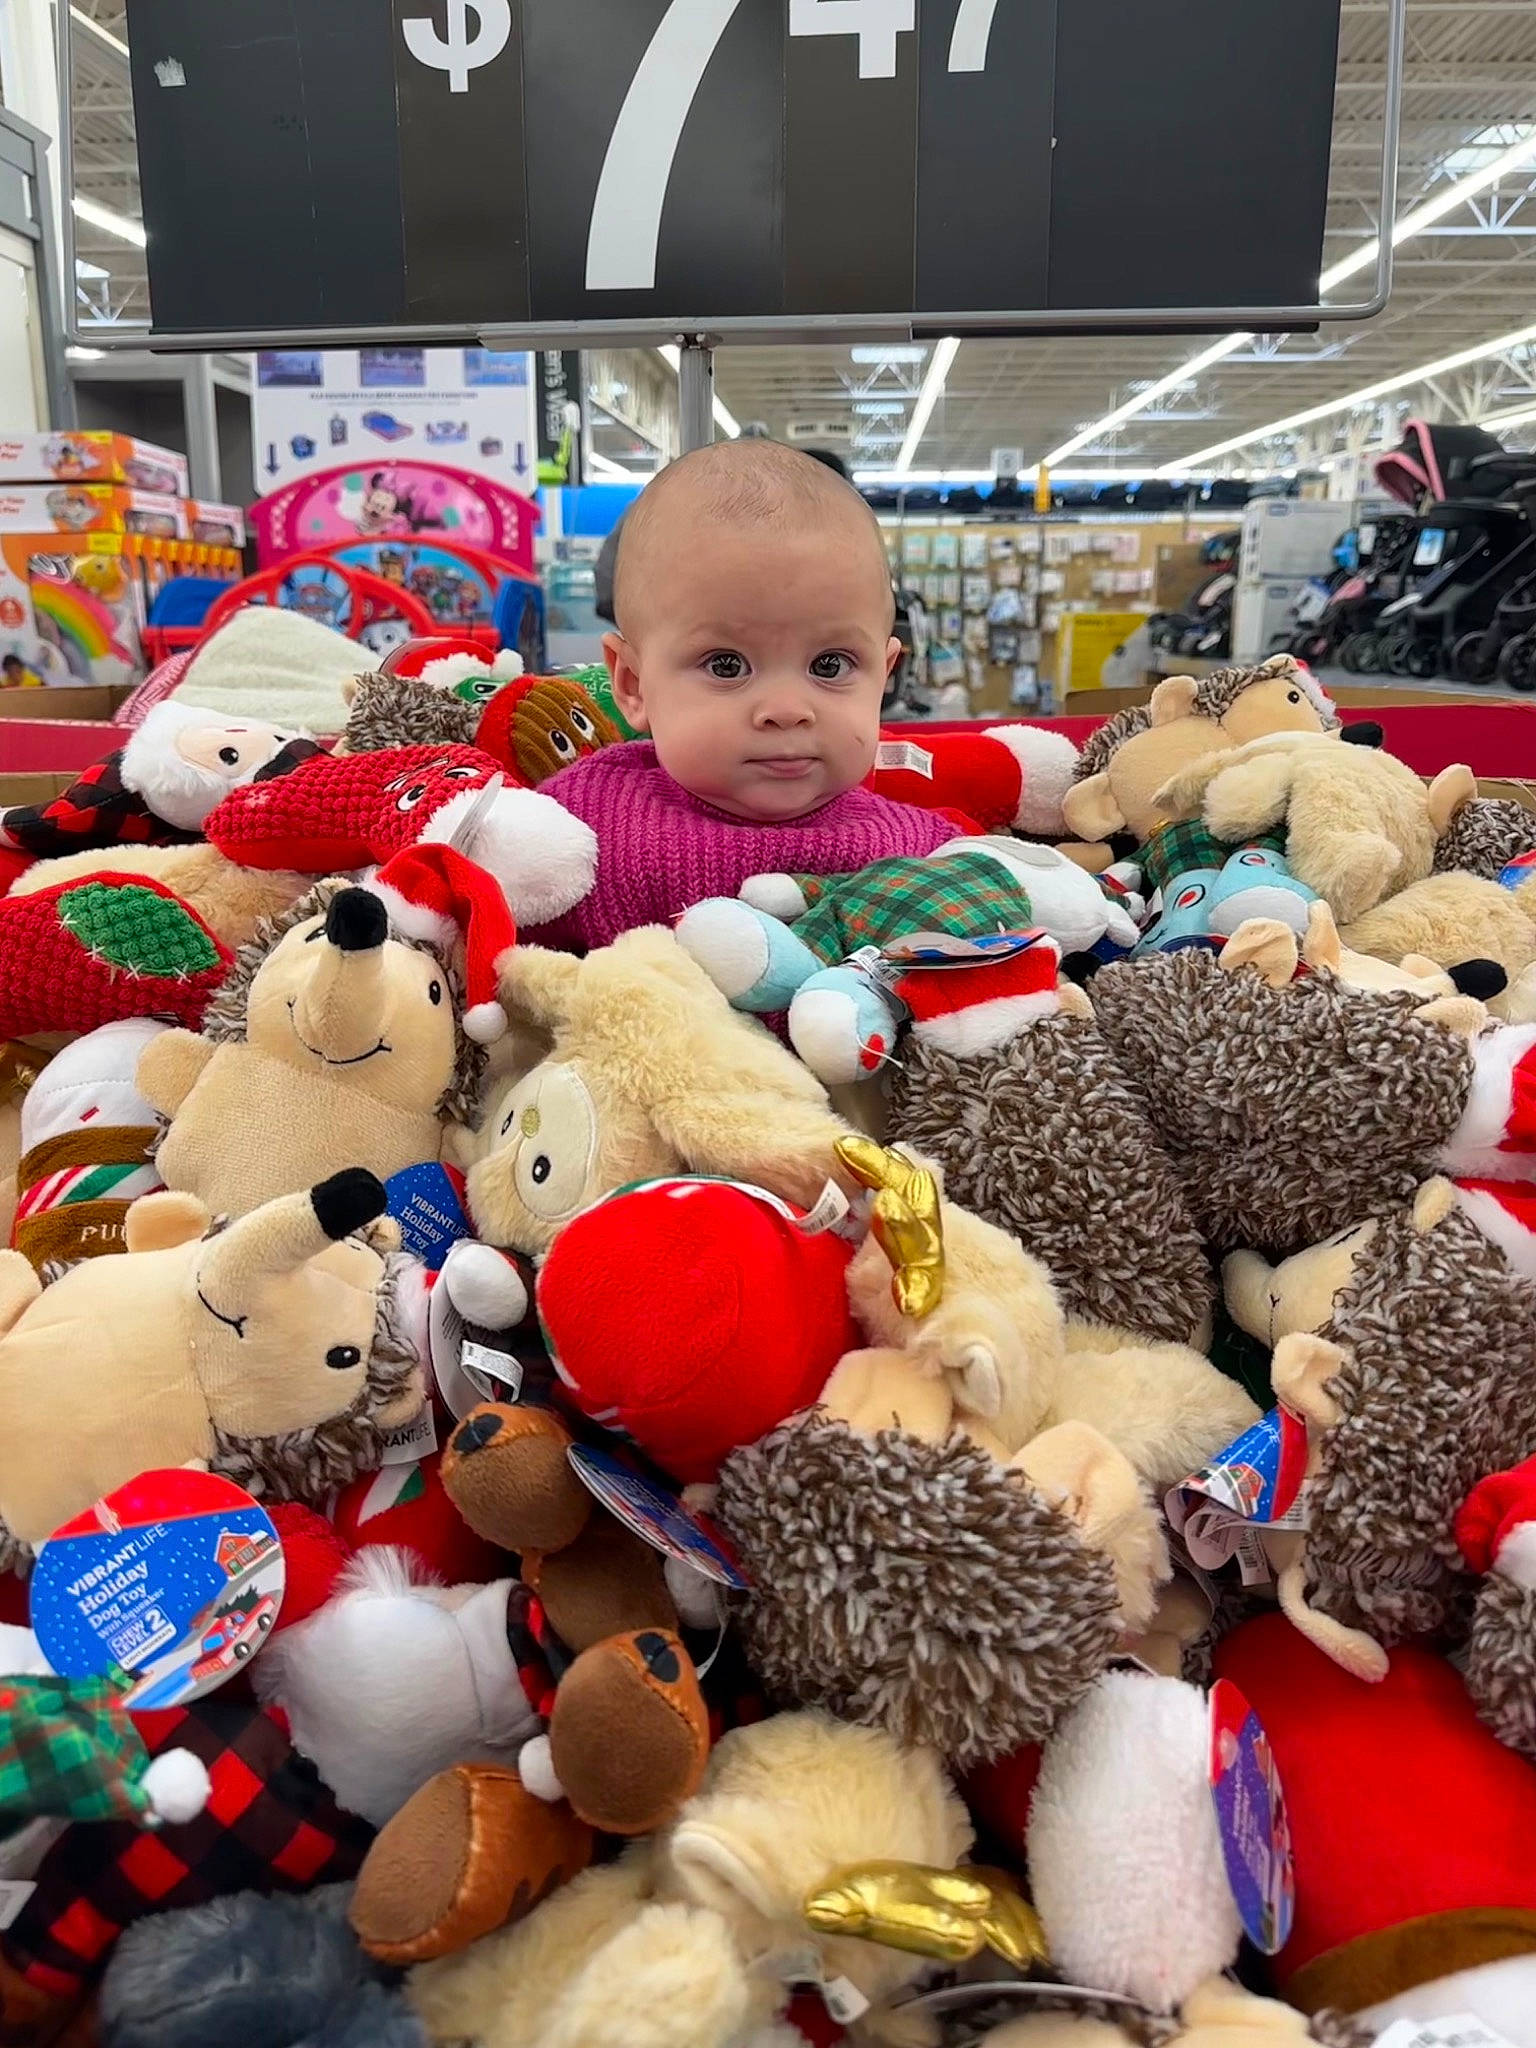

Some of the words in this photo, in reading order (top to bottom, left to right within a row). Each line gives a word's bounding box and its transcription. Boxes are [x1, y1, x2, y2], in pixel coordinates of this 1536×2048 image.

[400, 1206, 444, 1245] Holiday
[411, 1230, 430, 1250] Toy
[66, 1523, 169, 1597] VIBRANTLIFE
[77, 1559, 149, 1616] Holiday
[88, 1597, 122, 1629] Dog
[119, 1583, 148, 1611] Toy
[111, 1619, 146, 1650] CHEW
[146, 1608, 166, 1632] 2
[116, 1630, 154, 1659] LEVEL
